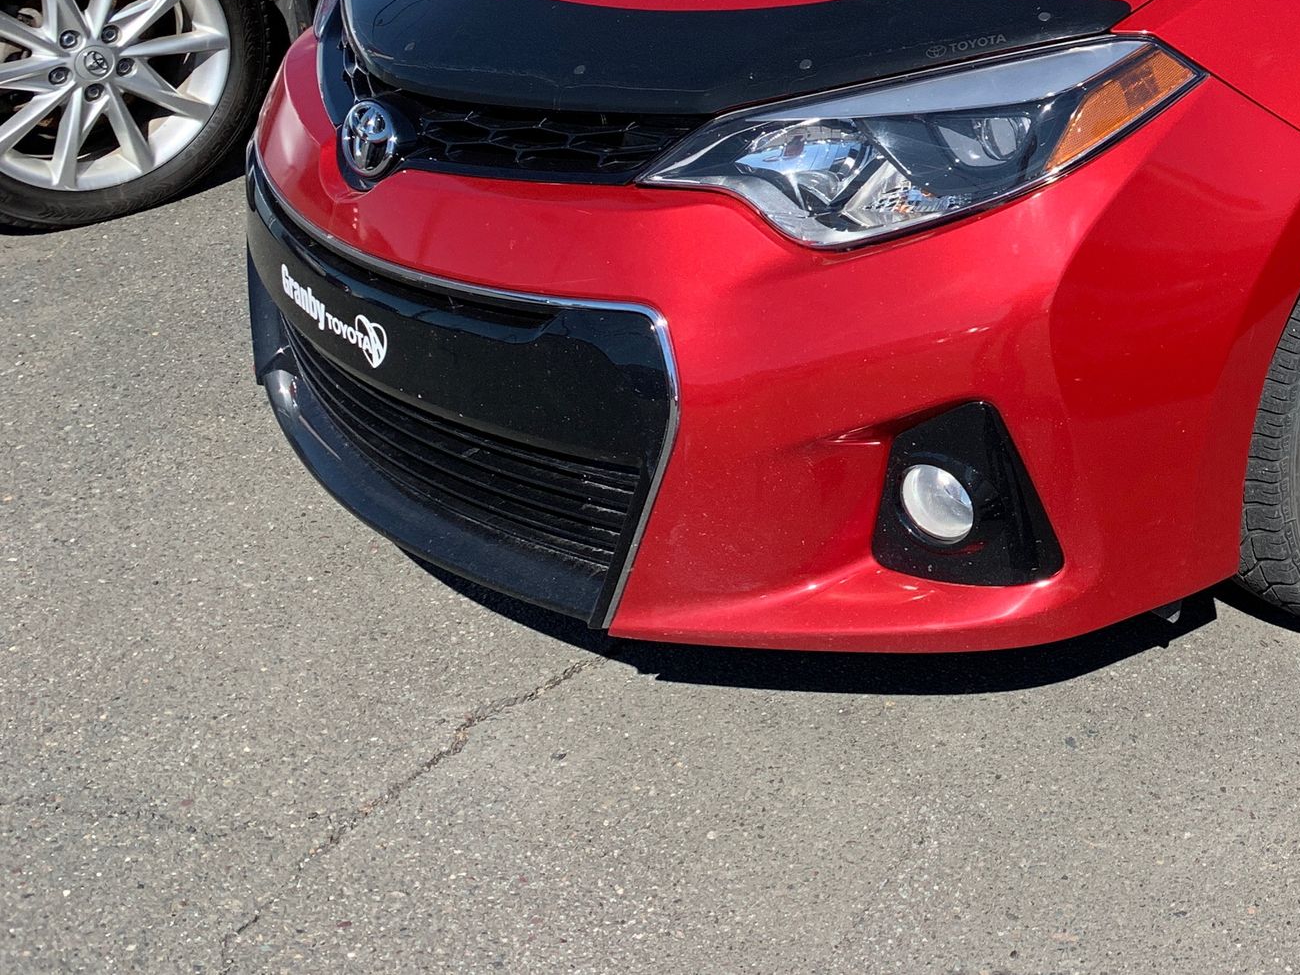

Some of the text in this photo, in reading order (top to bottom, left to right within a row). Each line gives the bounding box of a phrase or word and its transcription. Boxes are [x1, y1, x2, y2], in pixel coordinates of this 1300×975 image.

[949, 34, 1007, 52] TOYOTA
[281, 264, 373, 354] Granby TOYOTA
